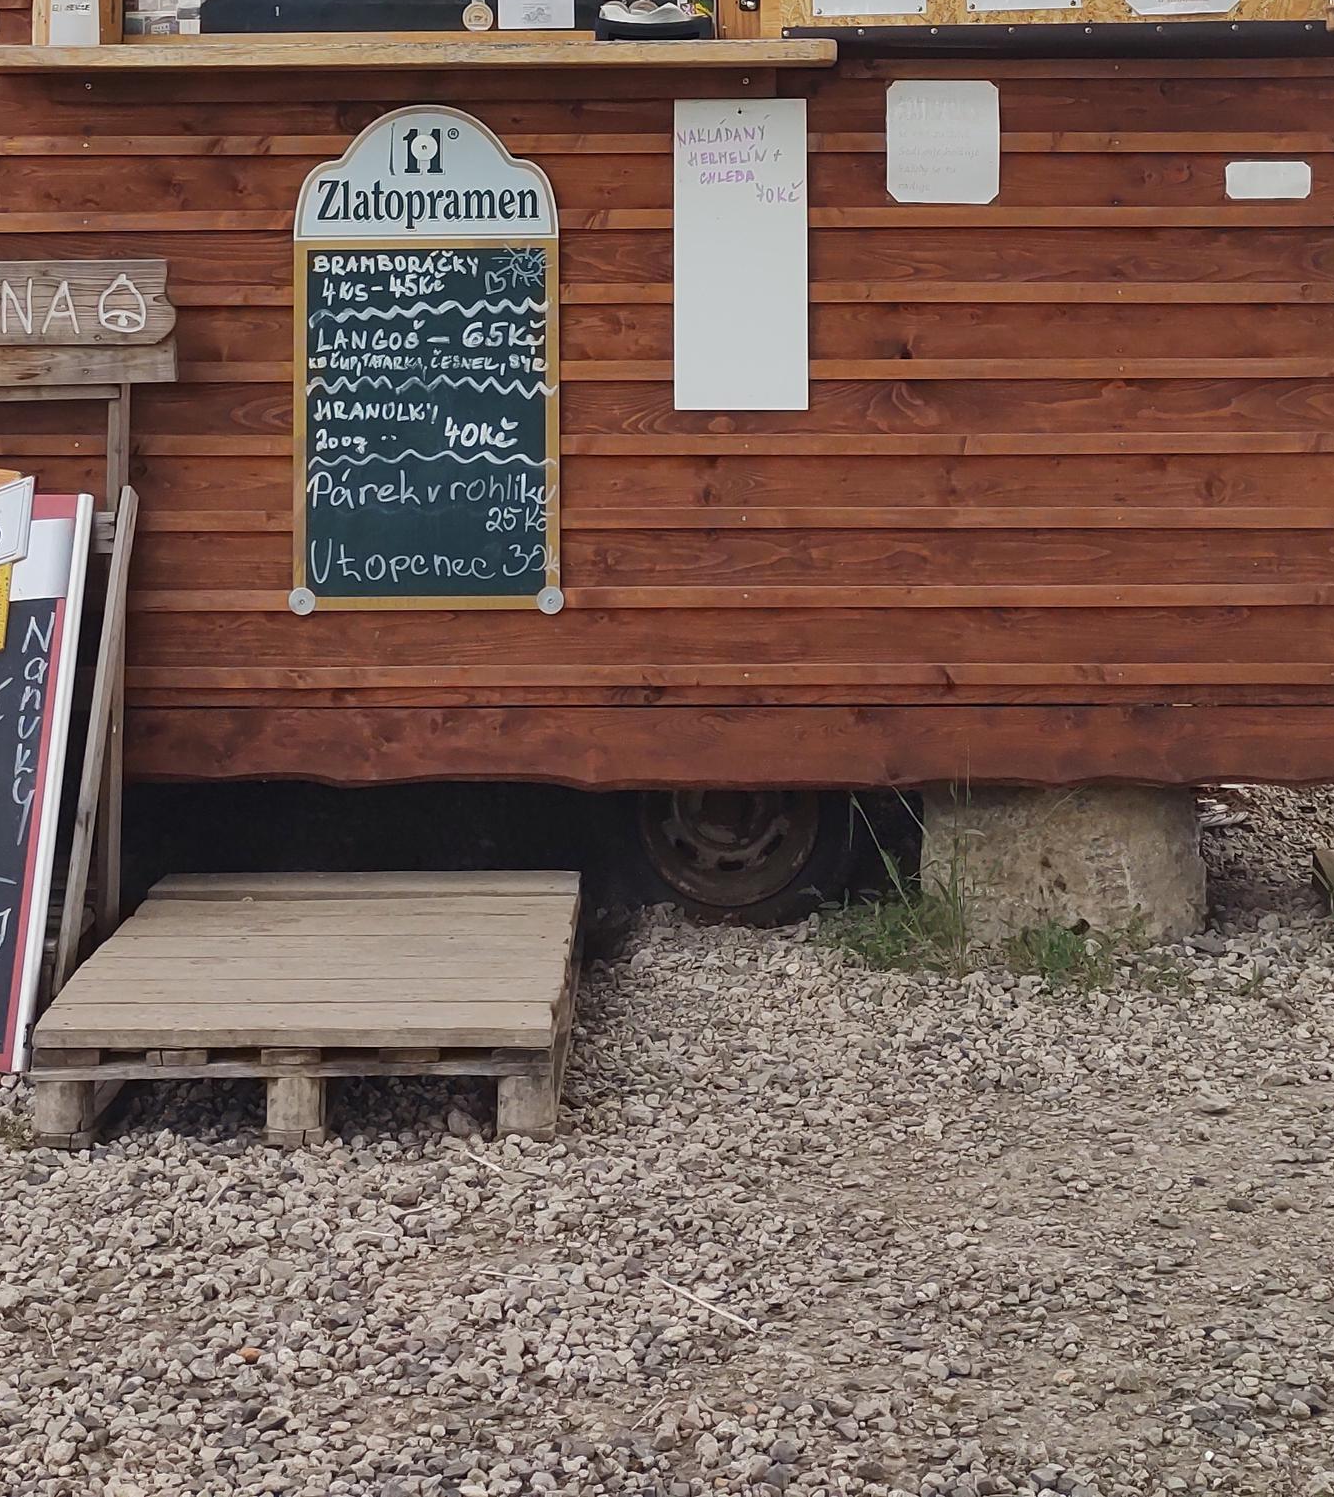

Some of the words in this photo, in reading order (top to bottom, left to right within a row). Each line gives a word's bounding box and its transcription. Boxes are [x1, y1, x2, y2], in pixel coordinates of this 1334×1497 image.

[676, 114, 771, 148] NAKLÁDANÝ
[688, 144, 767, 167] HERMELÍN
[699, 169, 755, 185] CHLEBA
[317, 179, 540, 230] Zlatopramen
[313, 250, 479, 278] BRAMBORÁČKY
[0, 277, 80, 335] NA
[316, 319, 426, 353] LANGOŠ
[307, 468, 421, 509] Párek
[427, 484, 441, 503] v
[486, 506, 523, 533] 25
